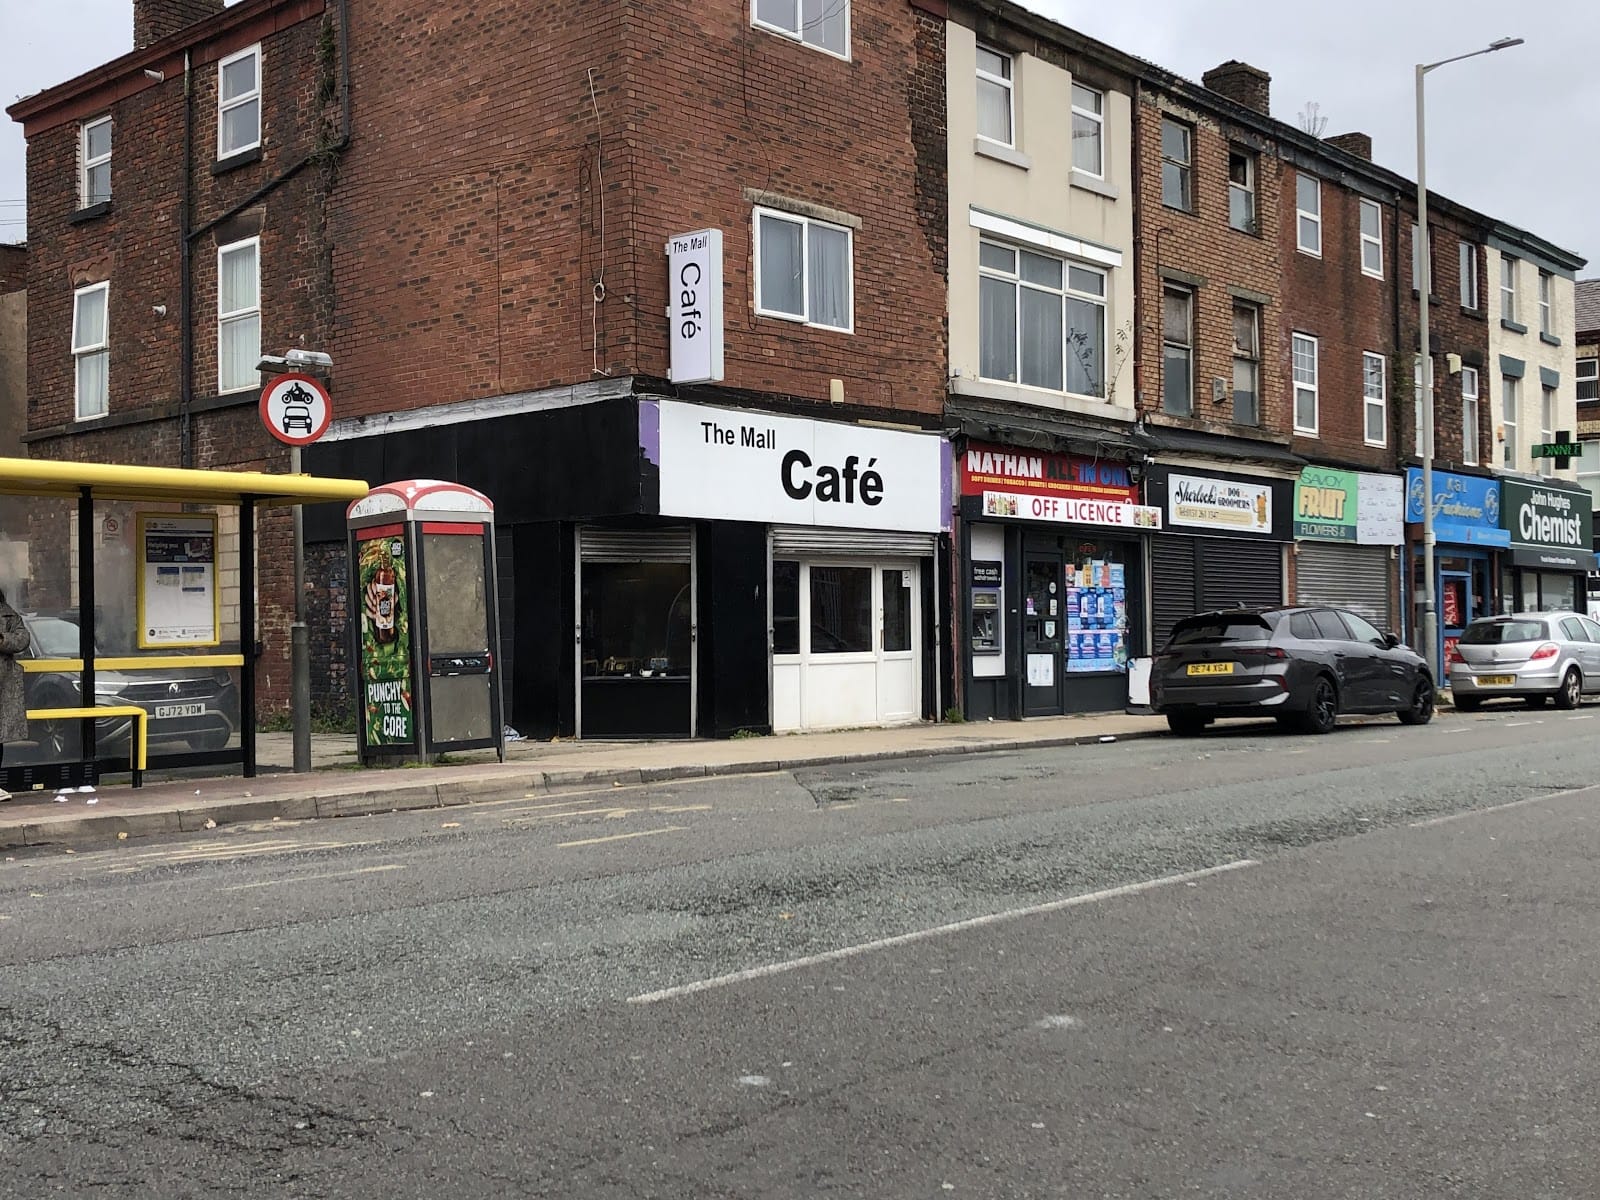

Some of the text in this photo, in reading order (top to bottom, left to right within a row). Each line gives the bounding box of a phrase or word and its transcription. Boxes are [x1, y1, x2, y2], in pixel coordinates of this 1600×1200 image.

[672, 235, 708, 254] The Mall
[680, 262, 702, 340] Café
[700, 421, 776, 450] The Mall
[967, 450, 1043, 479] NATHAN
[1046, 459, 1076, 482] ALL
[1079, 463, 1097, 484] IN
[781, 449, 884, 507] Café
[1300, 472, 1344, 487] SAVOY
[1217, 497, 1250, 509] GROOMERS
[1228, 488, 1240, 497] DOG
[1299, 485, 1347, 520] FRUIT
[1530, 490, 1571, 511] John Hughes
[1032, 497, 1122, 523] OFF LICENCE
[1301, 523, 1339, 536] FLOWERS
[1519, 503, 1582, 545] Chemist
[973, 566, 998, 575] free cash
[368, 681, 401, 702] PUNCHY
[383, 702, 401, 714] TO THE
[383, 715, 407, 738] CORE
